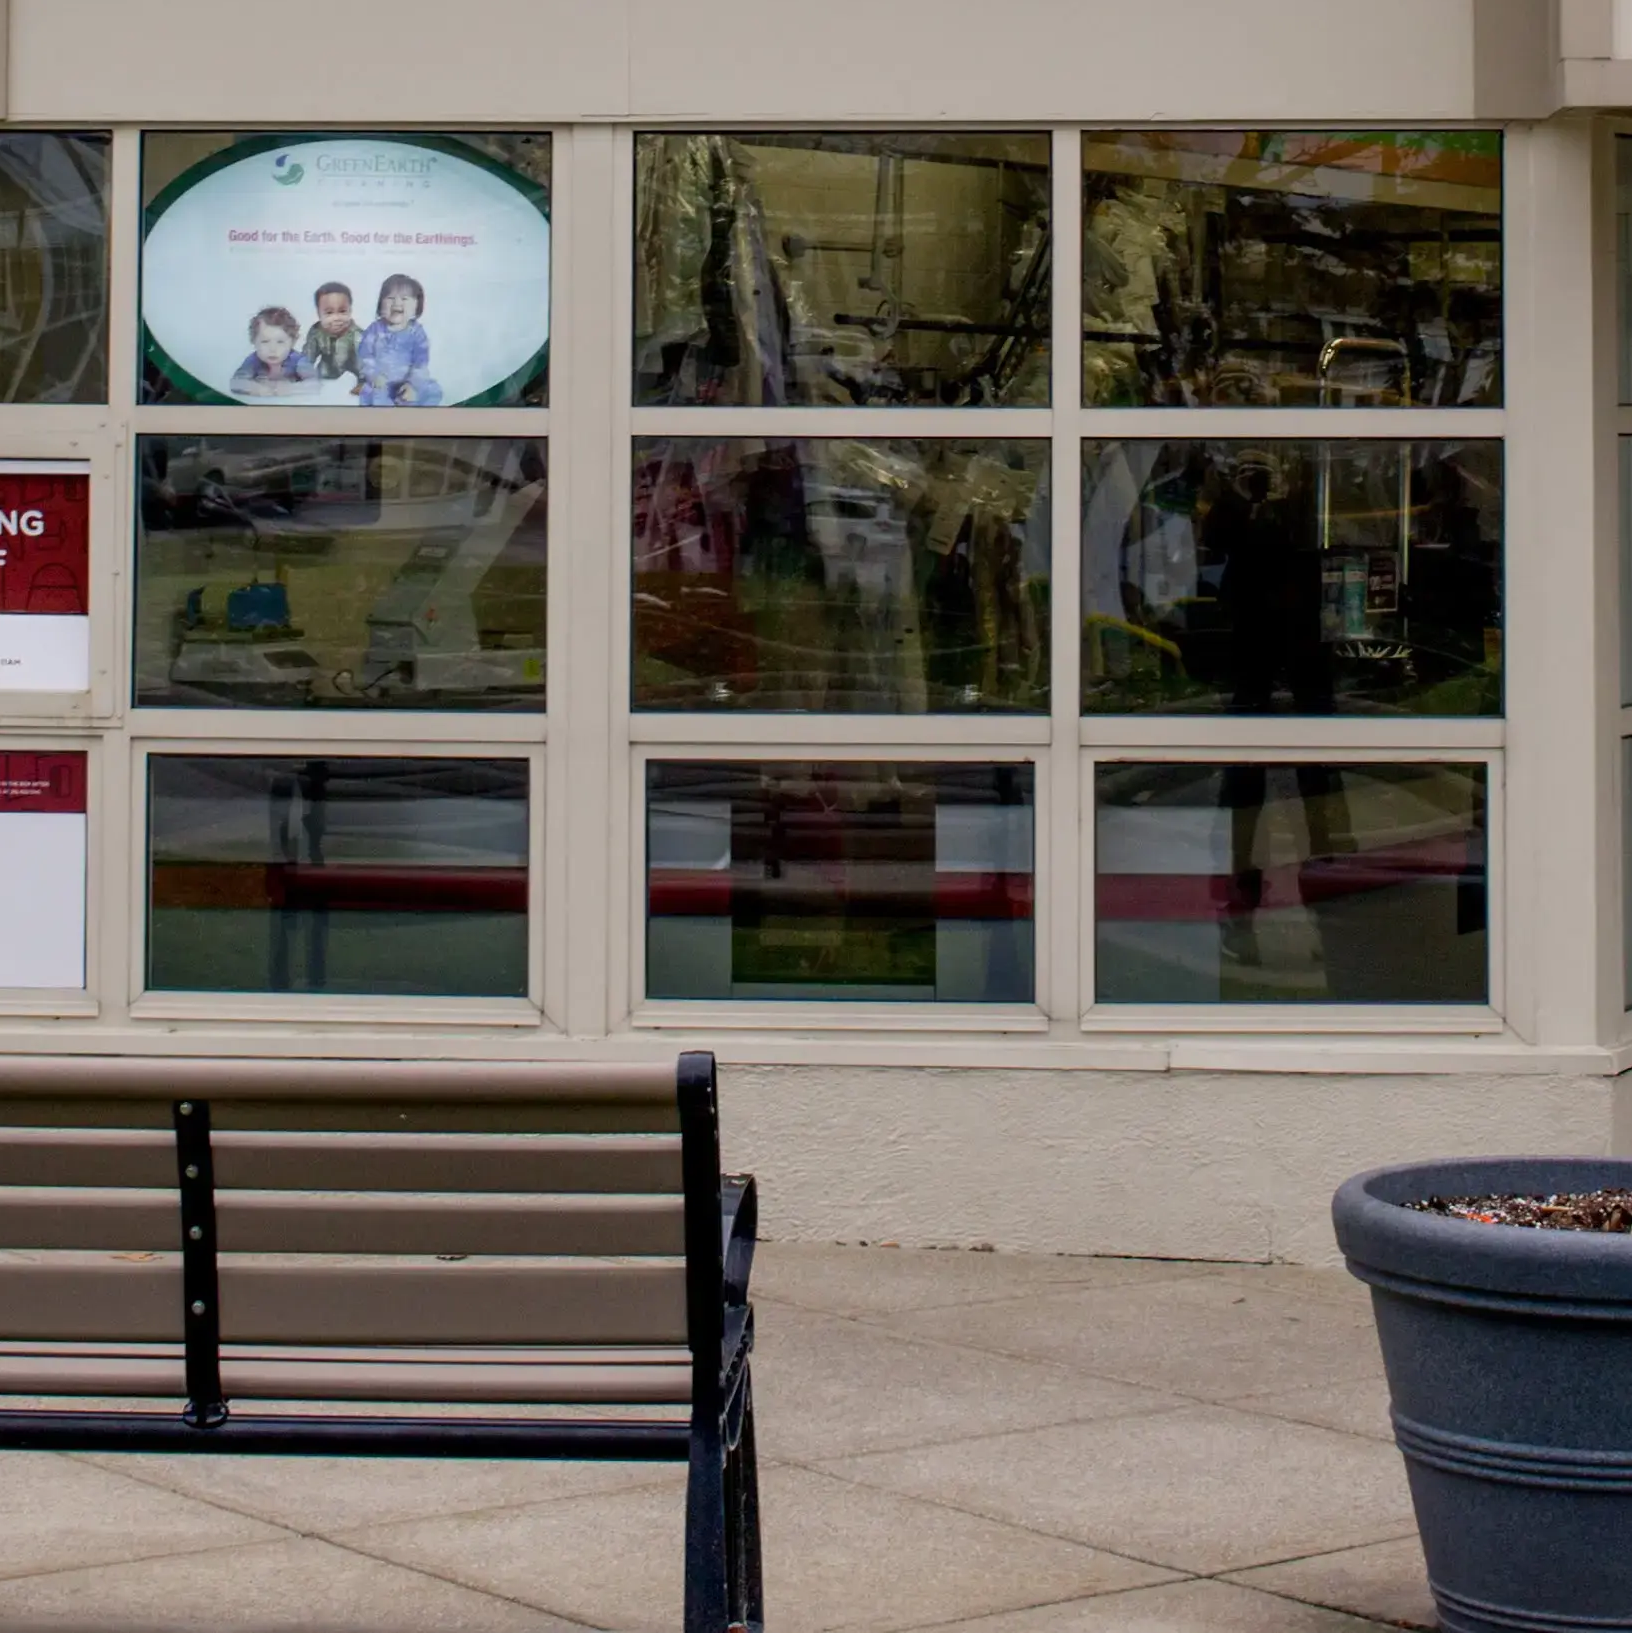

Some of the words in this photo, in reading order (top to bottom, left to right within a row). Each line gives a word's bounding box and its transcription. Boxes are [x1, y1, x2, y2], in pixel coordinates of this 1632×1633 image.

[228, 229, 259, 243] Good
[262, 230, 277, 243] for
[281, 230, 300, 243] the
[340, 231, 370, 244] Good
[373, 232, 390, 245] for
[393, 232, 413, 245] the
